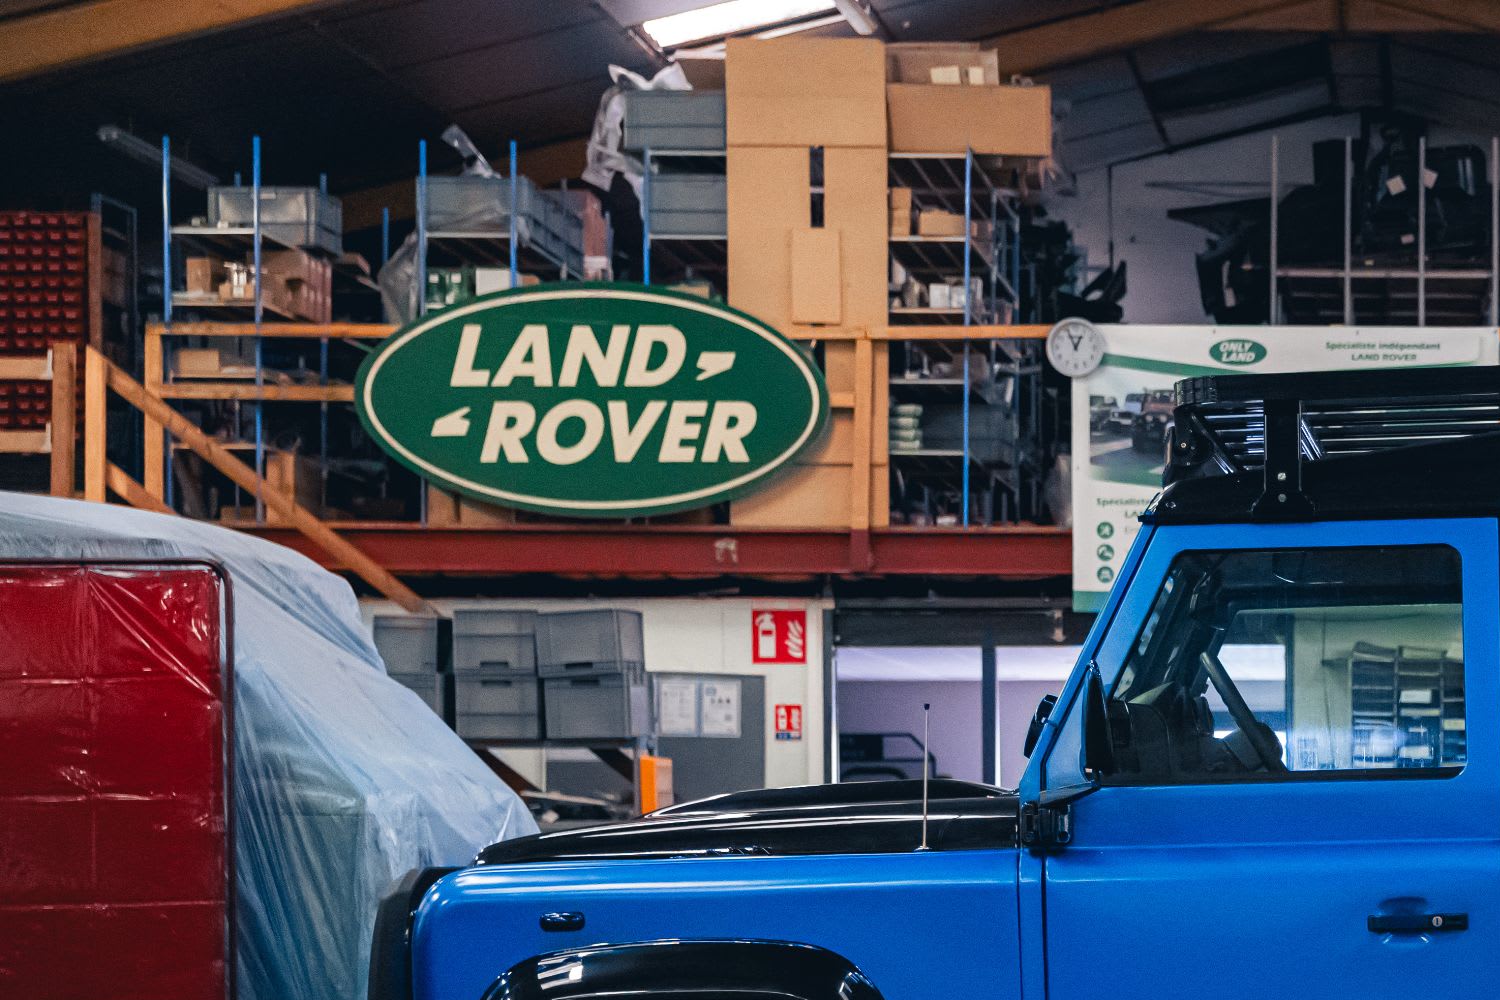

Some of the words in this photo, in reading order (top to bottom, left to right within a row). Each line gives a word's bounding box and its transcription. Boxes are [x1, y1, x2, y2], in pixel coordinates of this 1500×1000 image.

[450, 324, 687, 387] LAND
[1219, 341, 1253, 353] ONLY
[1222, 352, 1256, 362] LAND
[480, 399, 757, 465] ROVER
